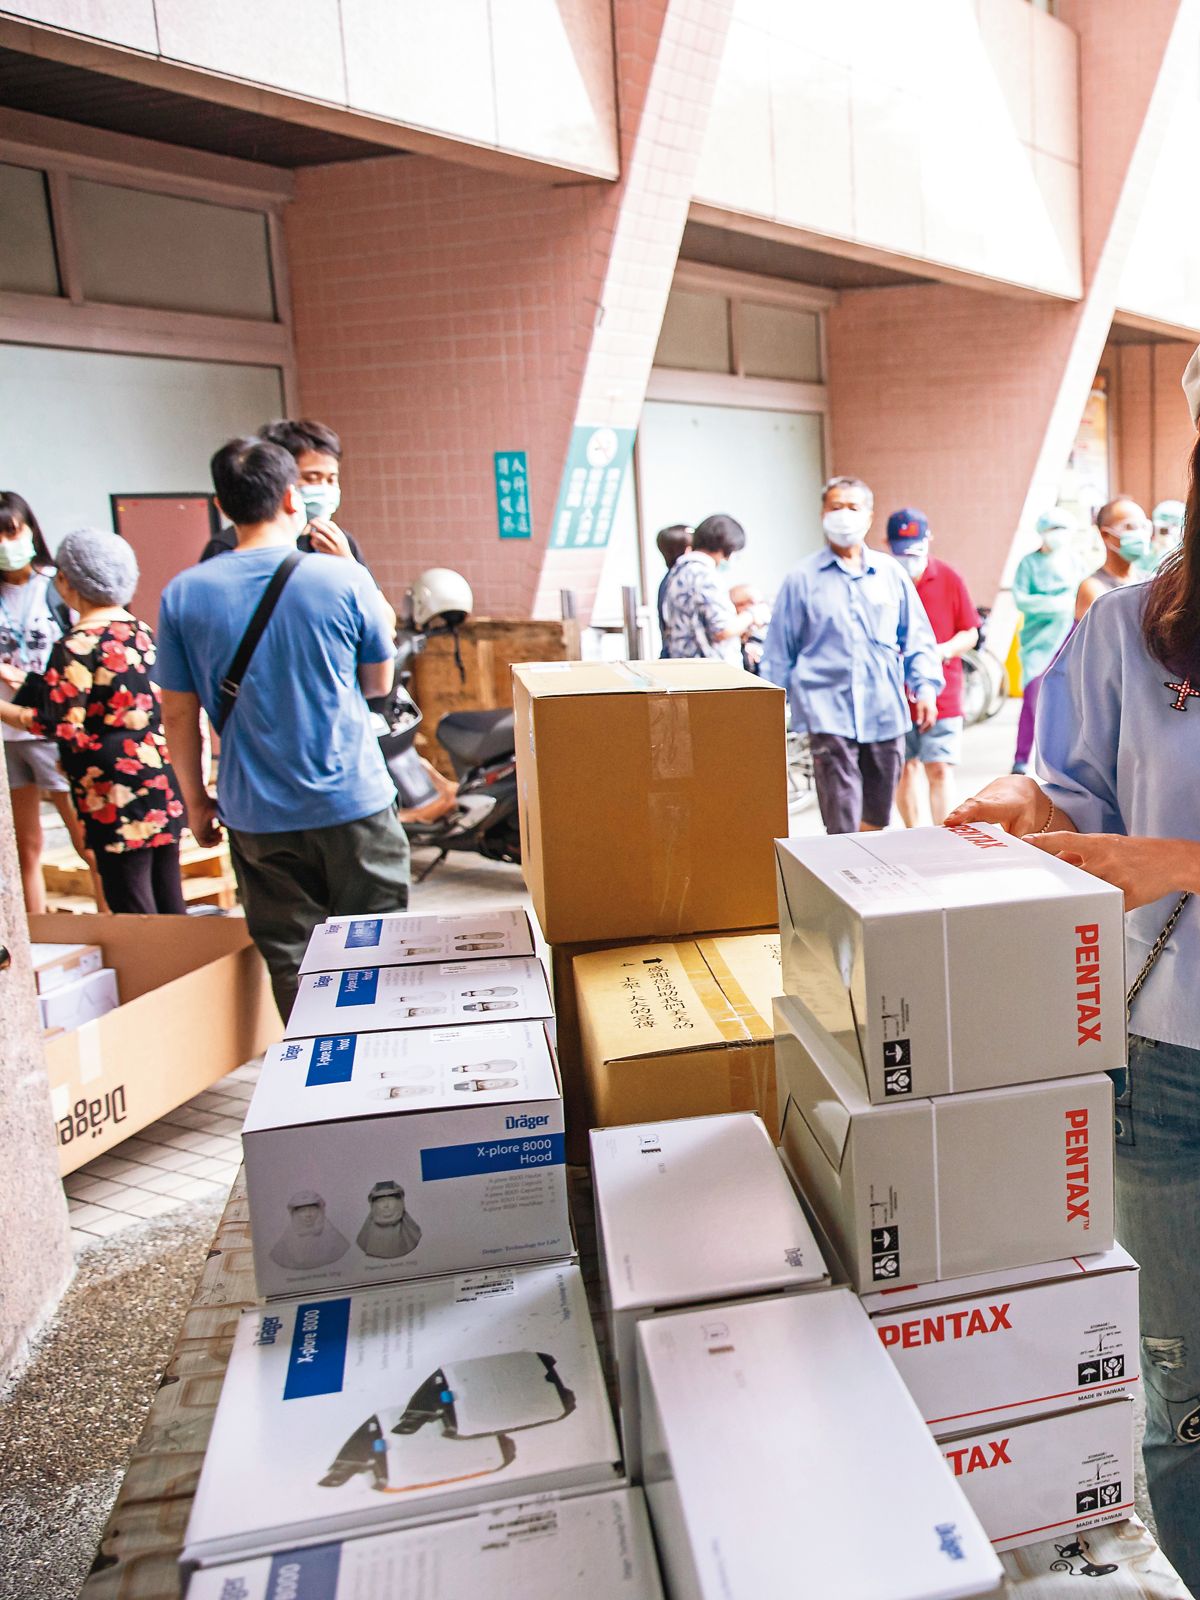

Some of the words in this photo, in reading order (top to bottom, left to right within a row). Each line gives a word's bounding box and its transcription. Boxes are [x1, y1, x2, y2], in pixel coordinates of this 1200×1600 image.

[1075, 923, 1102, 1047] PENTAX
[280, 1044, 304, 1061] Dräger
[320, 1040, 333, 1051] 8000
[336, 1038, 351, 1050] Hood
[316, 1051, 333, 1067] X-plore
[55, 1084, 127, 1145] Dräge
[505, 1114, 550, 1130] Dräger
[477, 1144, 520, 1158] X-plore
[522, 1139, 552, 1151] 8000
[520, 1151, 552, 1164] Hood
[302, 1310, 320, 1332] 8000
[877, 1303, 1013, 1349] PENTAX
[252, 1316, 283, 1346] Dräger
[297, 1333, 319, 1364] X-plore
[1078, 1393, 1095, 1401] MADE
[1104, 1386, 1126, 1396] TAIWAN
[1101, 1512, 1123, 1521] TAIWAN
